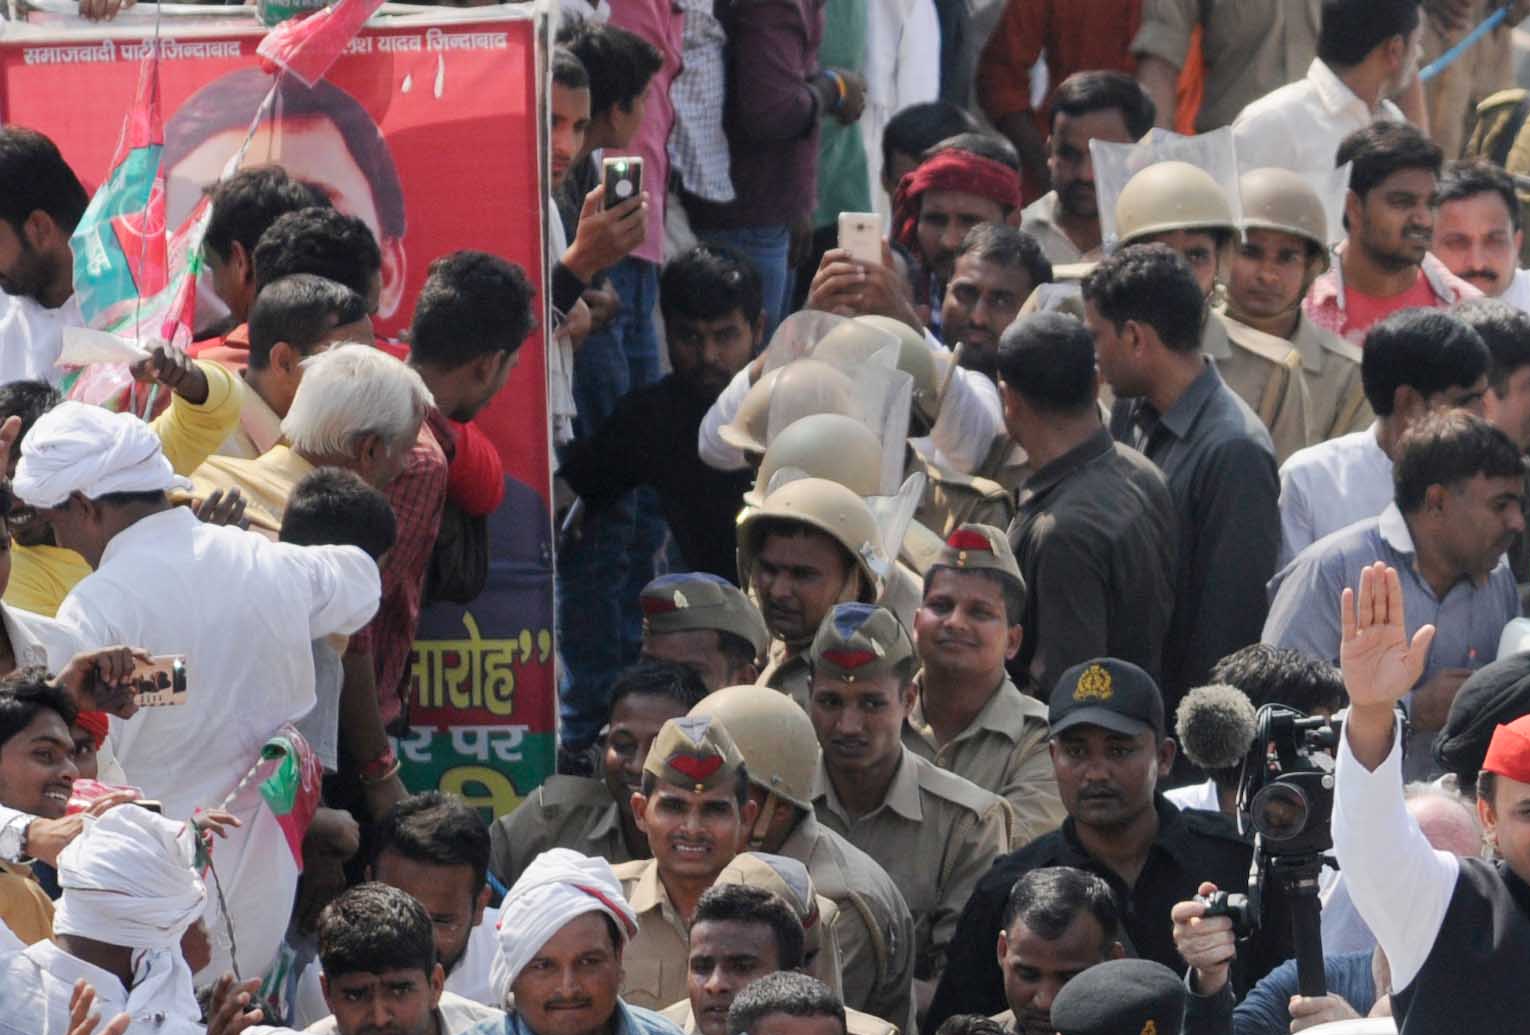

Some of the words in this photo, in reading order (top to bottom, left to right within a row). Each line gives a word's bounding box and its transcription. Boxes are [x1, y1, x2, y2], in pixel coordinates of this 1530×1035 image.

[24, 40, 116, 64] समाजवादी
[378, 34, 421, 52] यादव
[448, 724, 529, 763] पर
